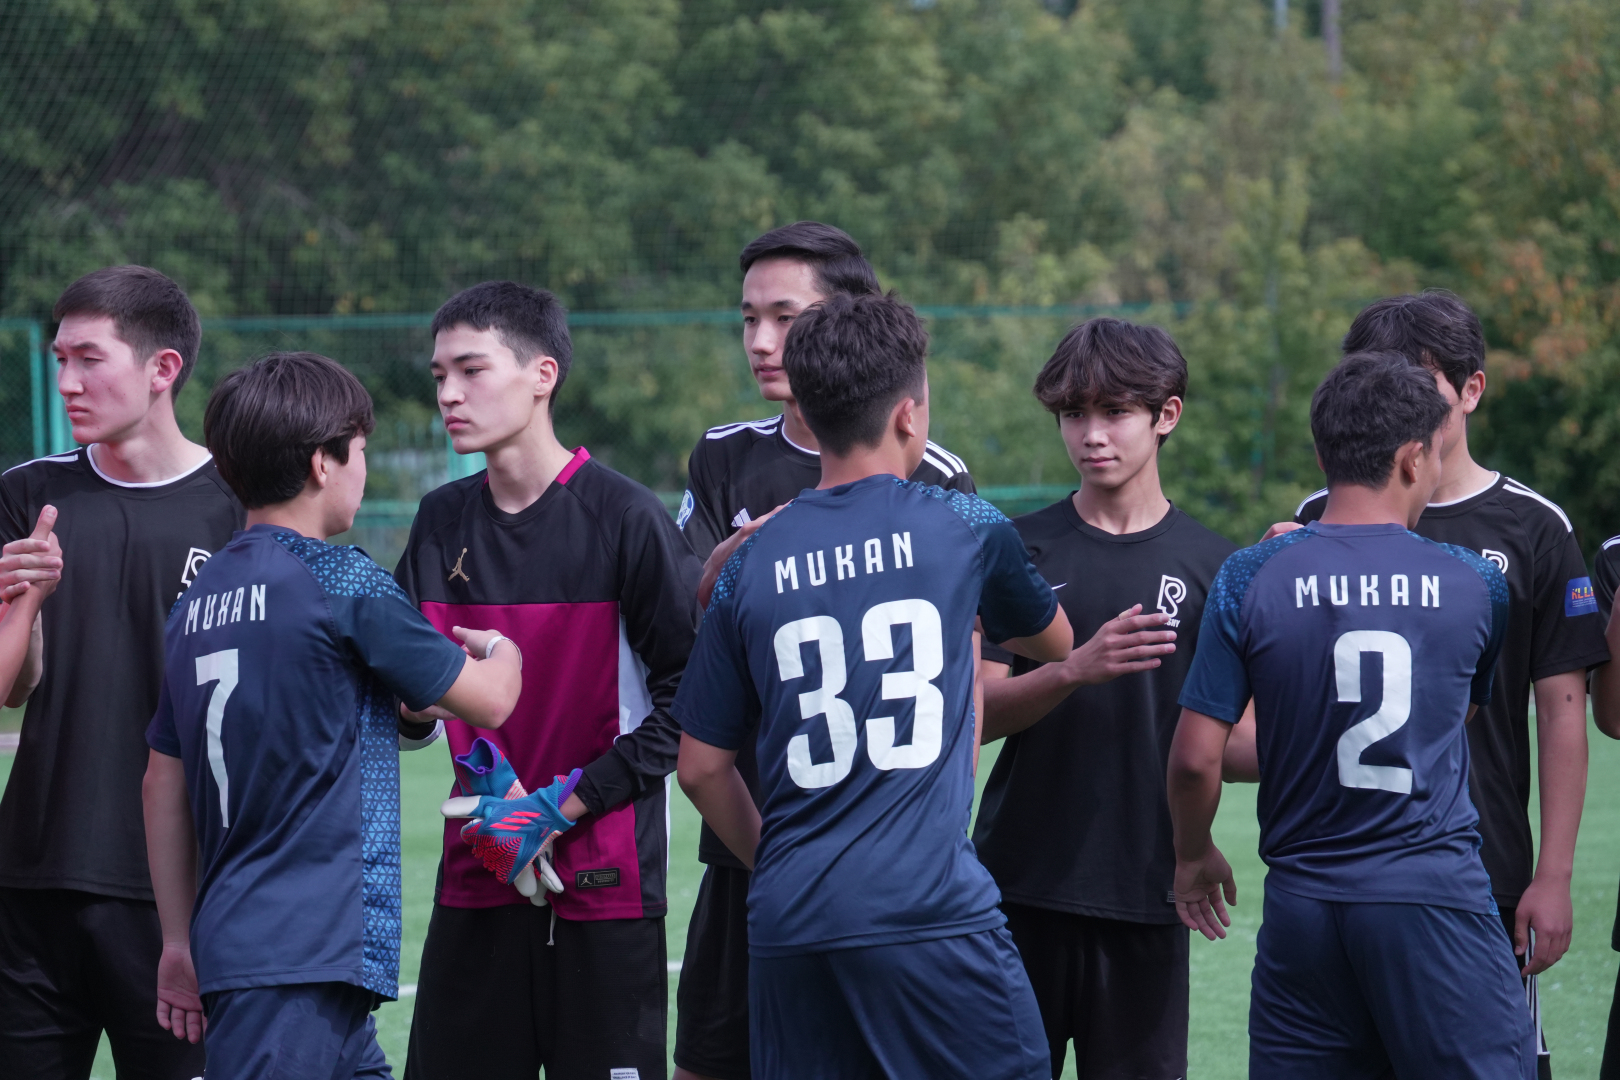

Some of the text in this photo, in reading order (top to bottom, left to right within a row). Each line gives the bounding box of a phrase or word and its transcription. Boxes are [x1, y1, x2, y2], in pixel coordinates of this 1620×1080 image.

[185, 584, 267, 636] MUKAN
[775, 531, 914, 594] MUKAN
[1295, 573, 1440, 609] MUKAN
[195, 648, 239, 828] 7
[773, 598, 945, 789] 33
[1333, 629, 1413, 795] 2
